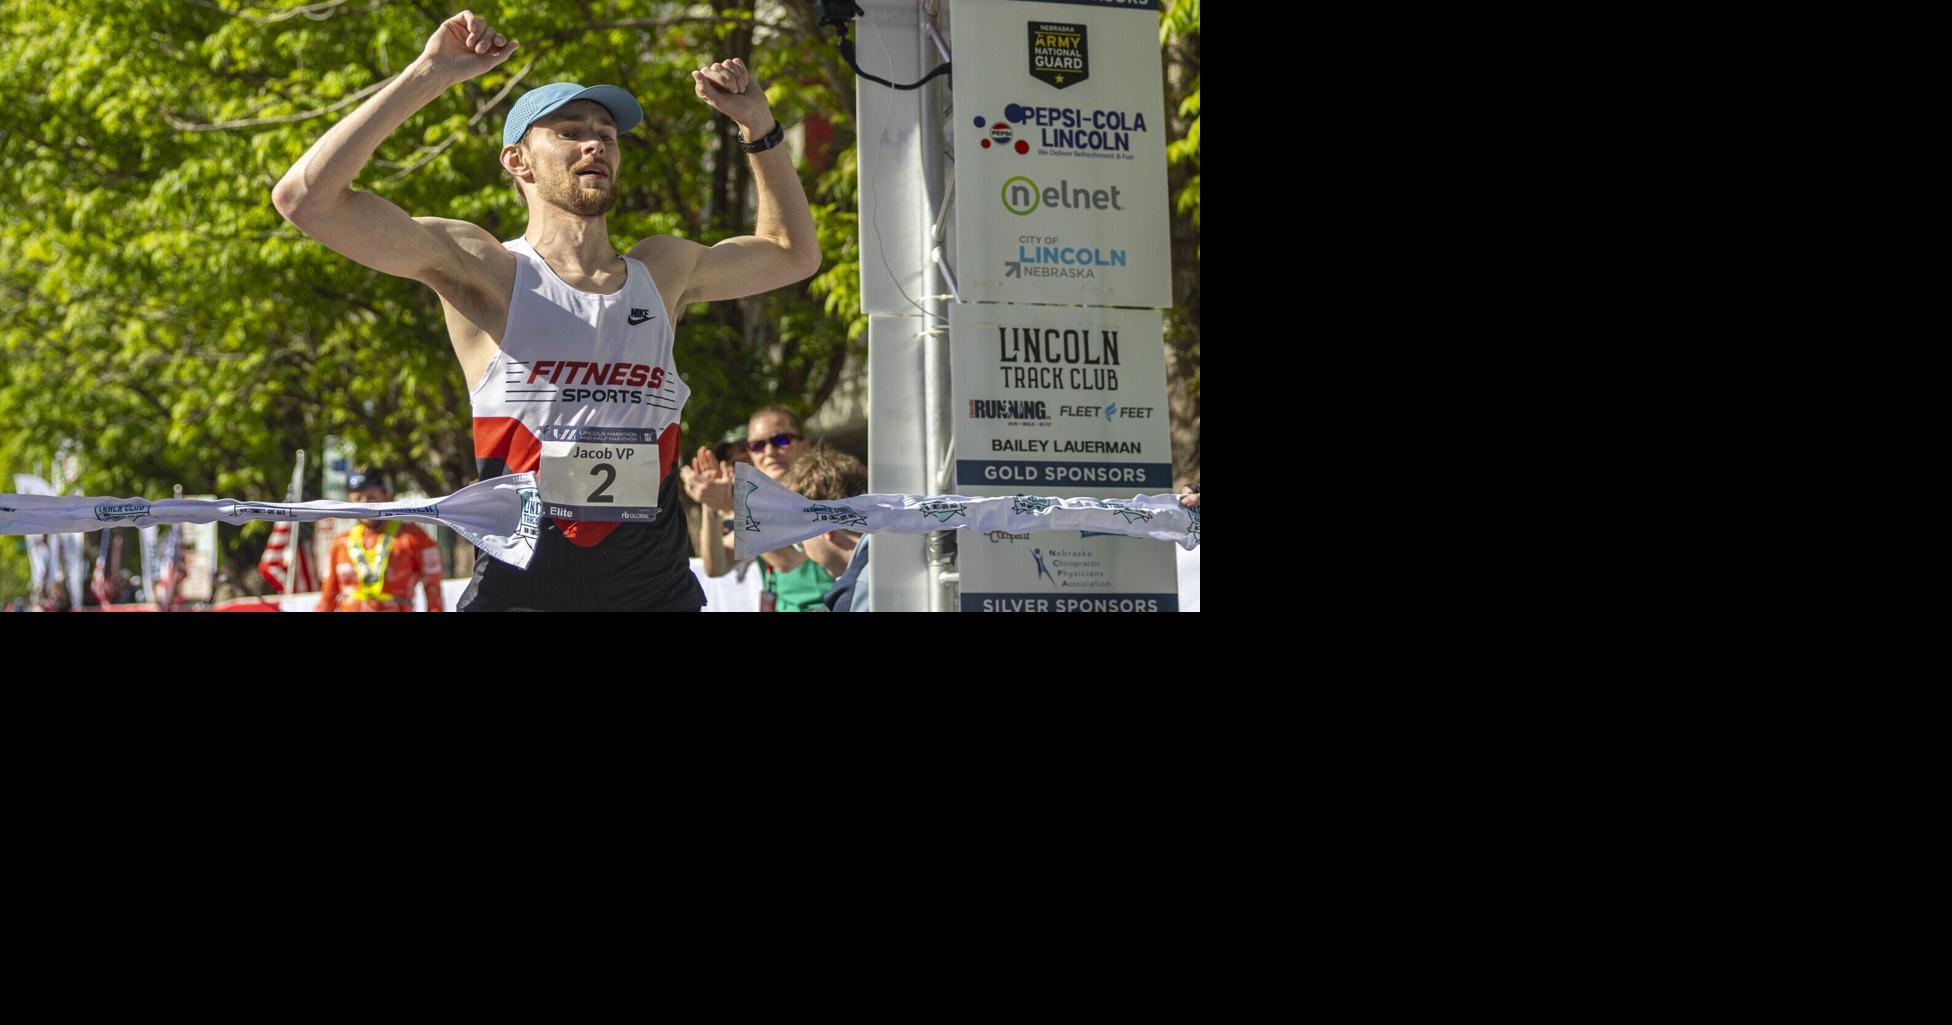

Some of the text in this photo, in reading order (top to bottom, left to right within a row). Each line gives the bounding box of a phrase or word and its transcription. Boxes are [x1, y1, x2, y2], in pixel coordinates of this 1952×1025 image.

[1040, 25, 1075, 33] NEBRASKA
[1035, 35, 1080, 48] ARMY
[1034, 48, 1082, 57] NATIONAL
[1035, 56, 1083, 69] GUARD
[1021, 106, 1147, 132] PEPSI-COLA
[1041, 128, 1130, 151] LINCOLN
[1010, 180, 1121, 211] nelnet
[1018, 235, 1059, 245] CITY OF
[1019, 246, 1126, 267] LINCOLN
[1024, 266, 1095, 279] NEBRASKA
[630, 307, 650, 319] NIKE
[998, 326, 1120, 366] LINCOLN
[526, 360, 666, 390] FITNESS
[1000, 366, 1119, 391] TRACK CLUB
[561, 388, 642, 404] SPORTS
[974, 399, 1046, 420] RUNNING
[1060, 405, 1154, 419] FLEET FEET
[572, 447, 635, 460] Jacob VP
[991, 439, 1142, 454] BAILEY LAUERMAN
[984, 465, 1146, 482] GOLD SPONSORS
[586, 462, 617, 503] 2
[550, 506, 573, 518] Elite
[1049, 549, 1092, 558] Nebraska
[1052, 559, 1102, 569] Chiropractic
[1057, 569, 1104, 579] Physicians
[1062, 580, 1111, 588] Association
[983, 599, 1158, 613] SILVER SPONSORS
